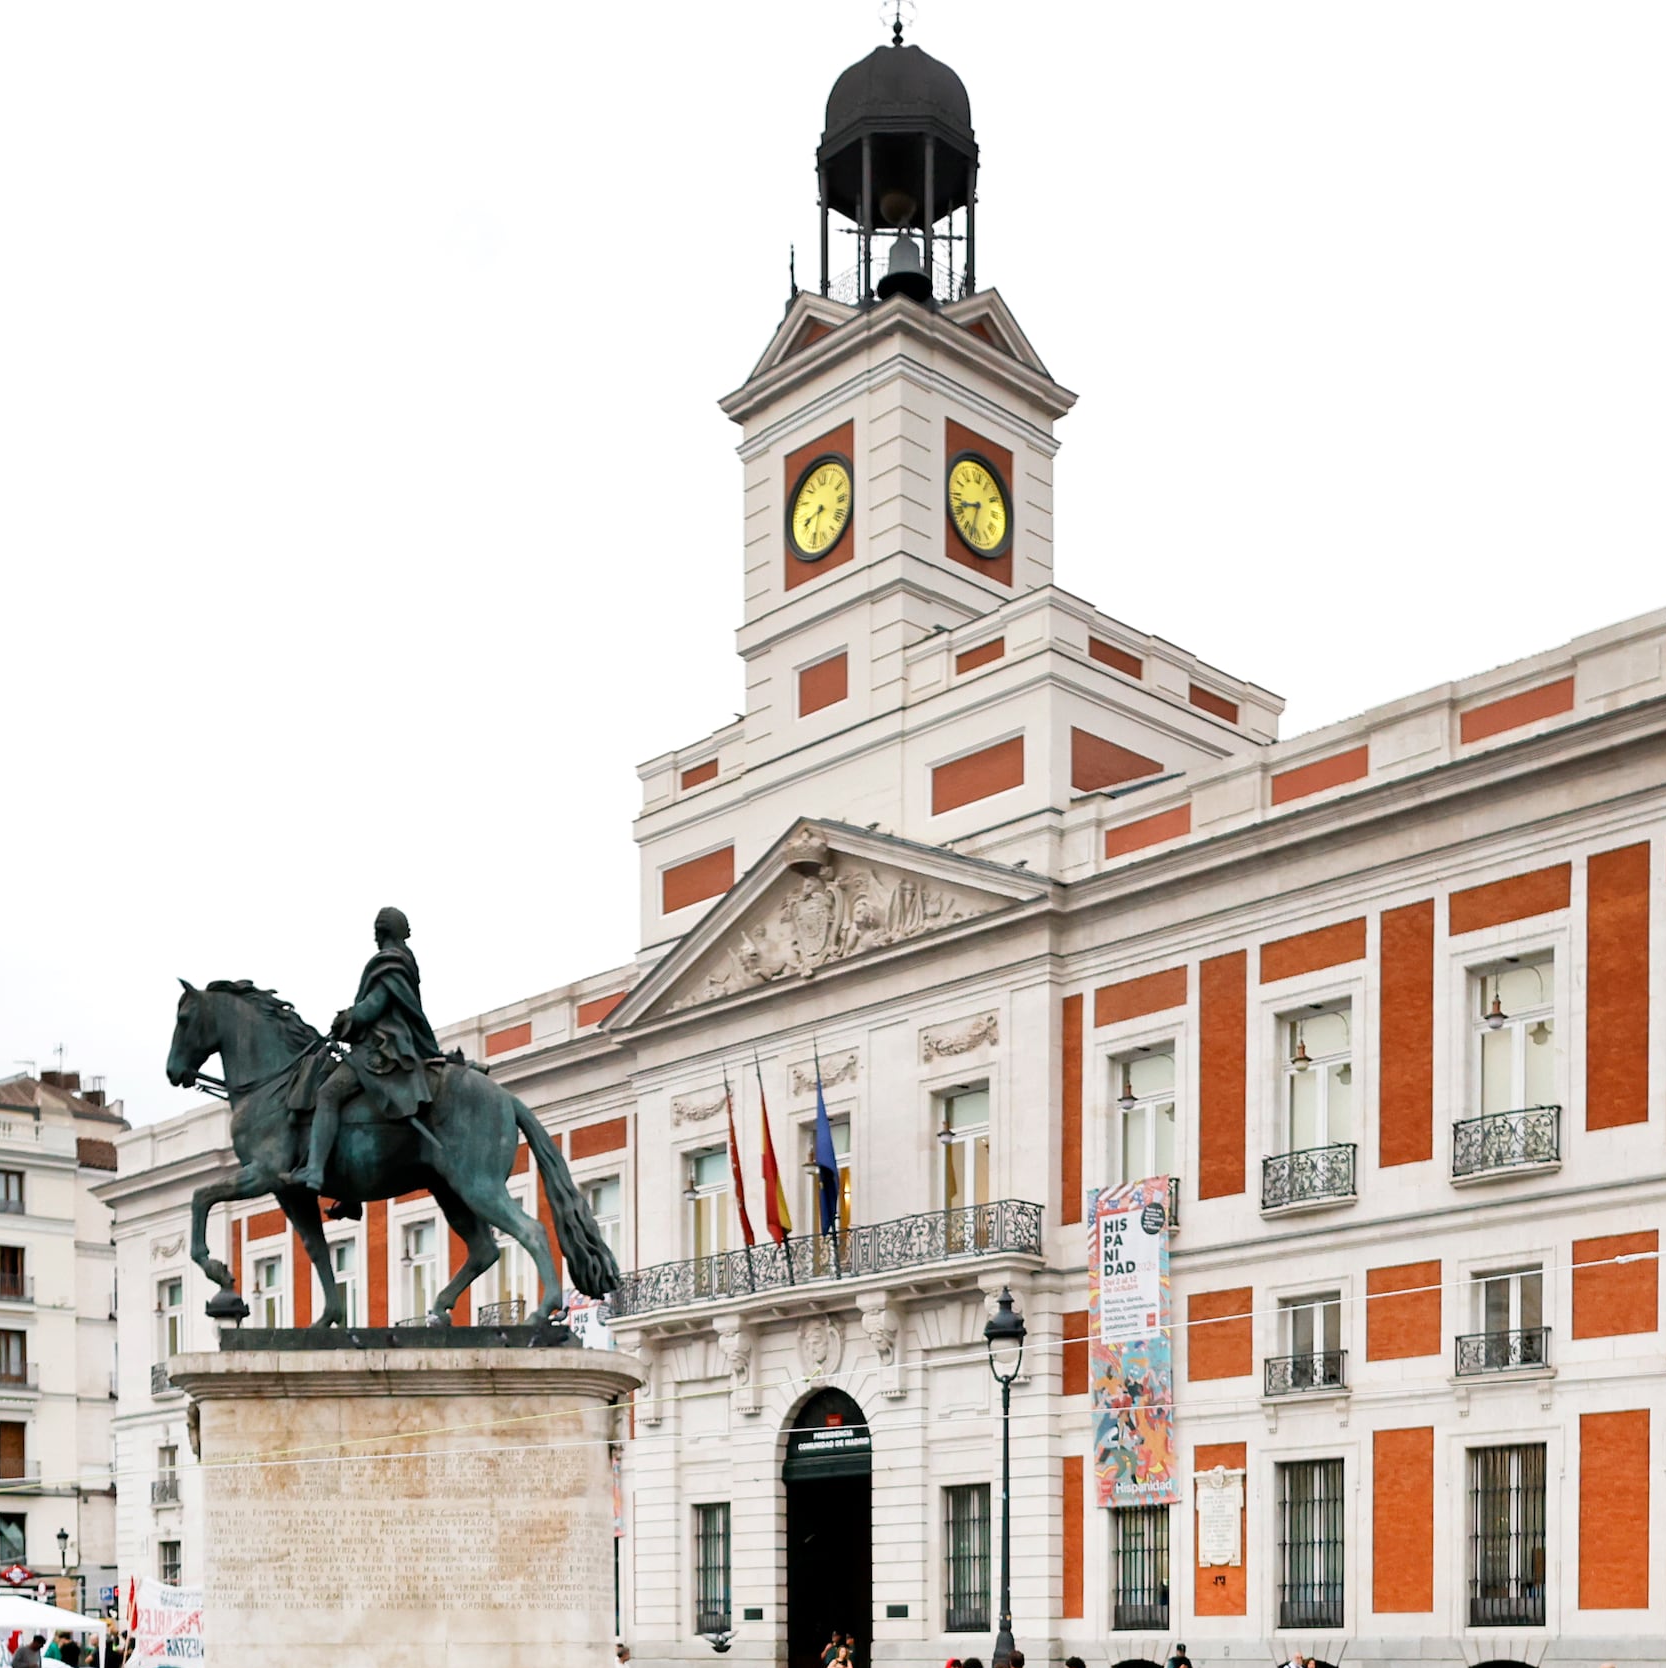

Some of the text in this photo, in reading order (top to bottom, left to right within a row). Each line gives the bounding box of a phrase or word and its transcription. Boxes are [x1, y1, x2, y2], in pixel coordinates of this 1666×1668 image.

[1104, 1218, 1128, 1233] HIS
[1104, 1233, 1123, 1248] PA
[1104, 1249, 1119, 1262] NI
[1104, 1261, 1136, 1277] DAD
[813, 1429, 853, 1440] PRESIDENCIA
[798, 1437, 870, 1451] COMUNIDAD DE MADRID
[1115, 1479, 1173, 1494] Hispanidad
